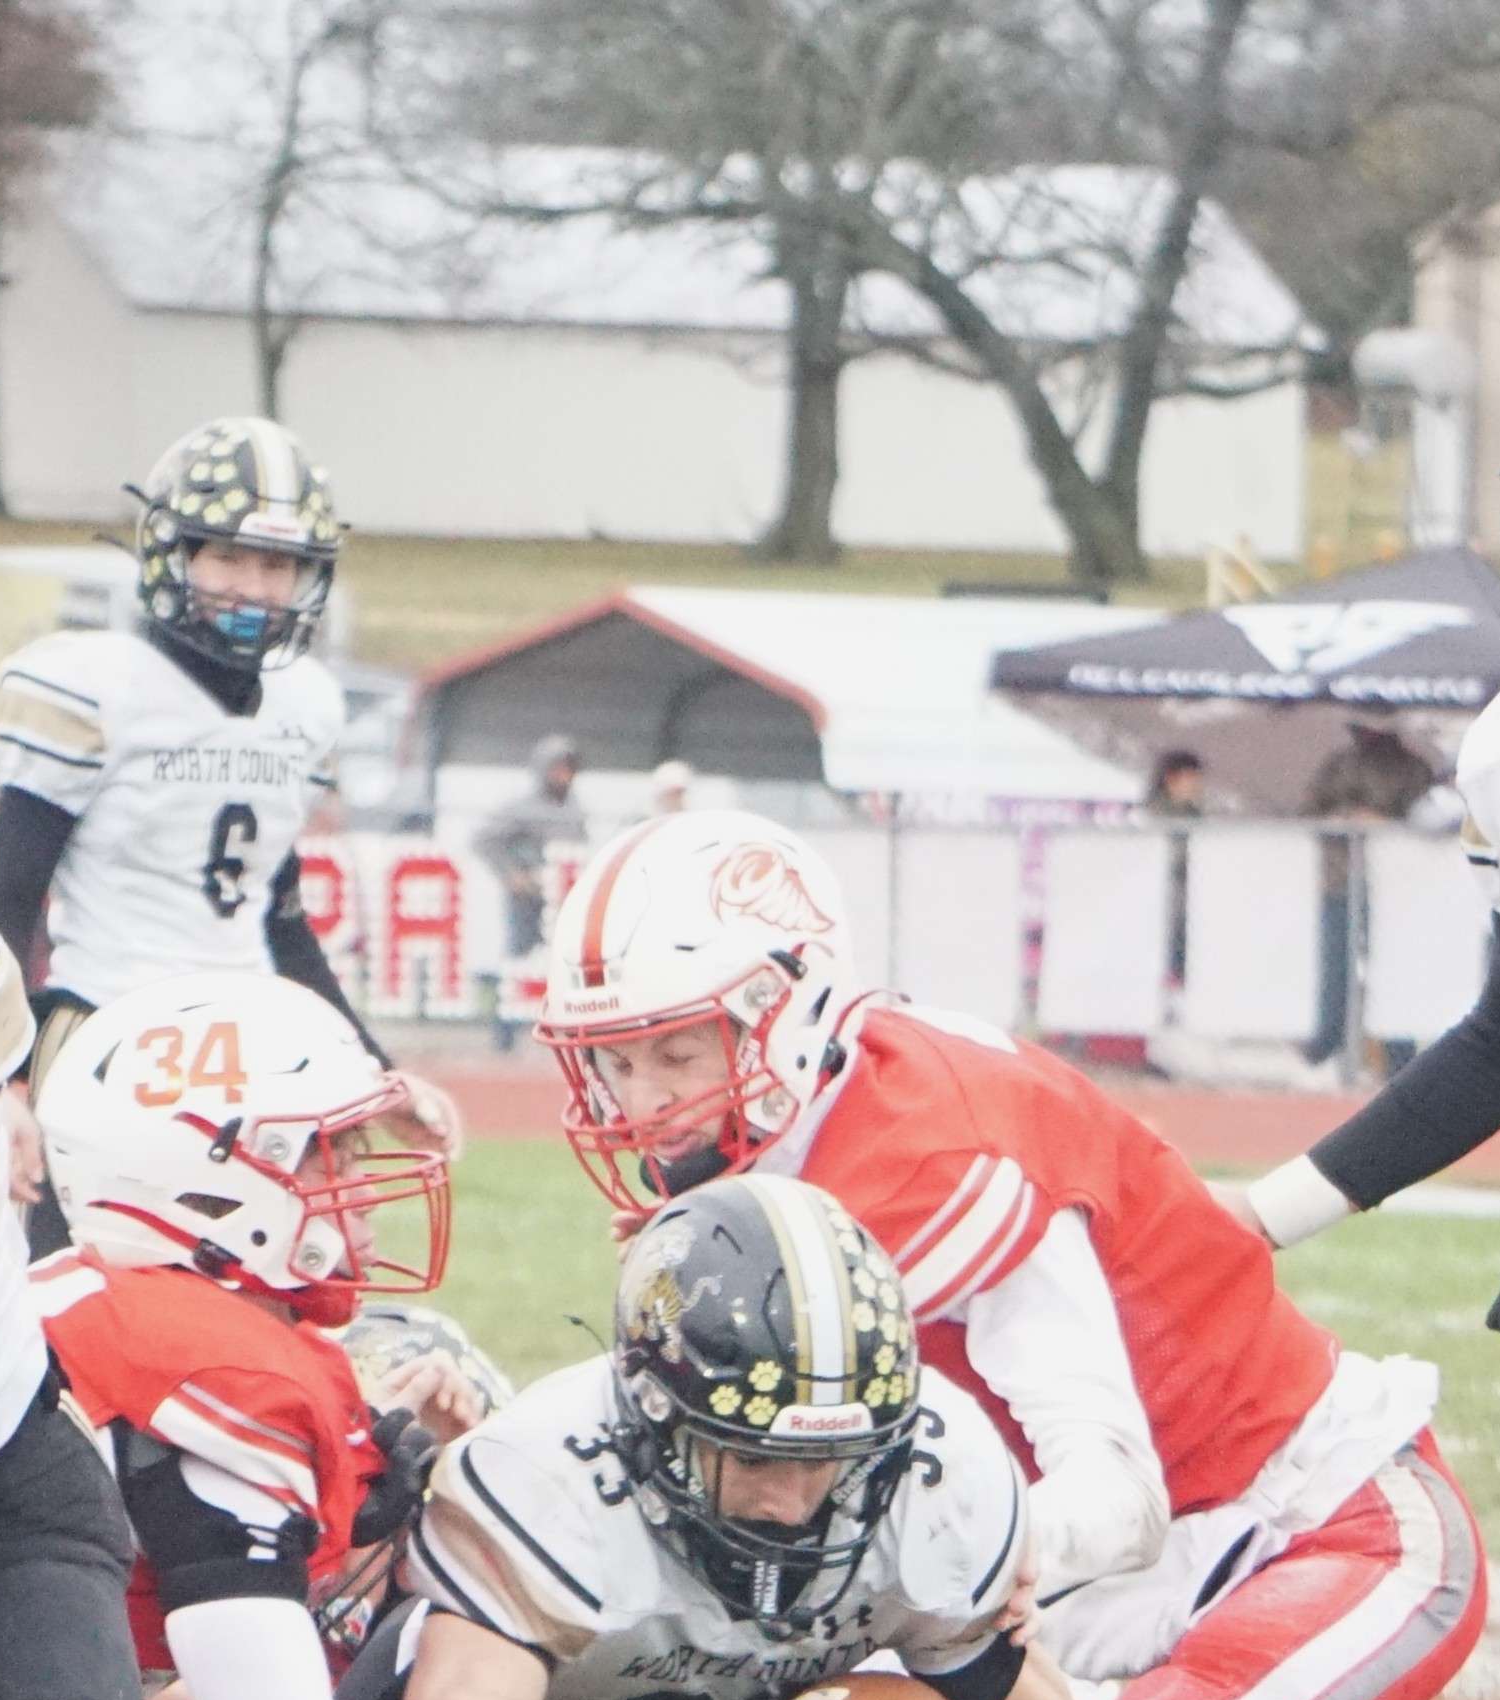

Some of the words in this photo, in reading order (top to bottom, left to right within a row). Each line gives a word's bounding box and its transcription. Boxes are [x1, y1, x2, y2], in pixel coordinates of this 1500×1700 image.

[202, 802, 258, 919] 6
[134, 1021, 248, 1108] 34
[790, 1413, 862, 1431] Riddell
